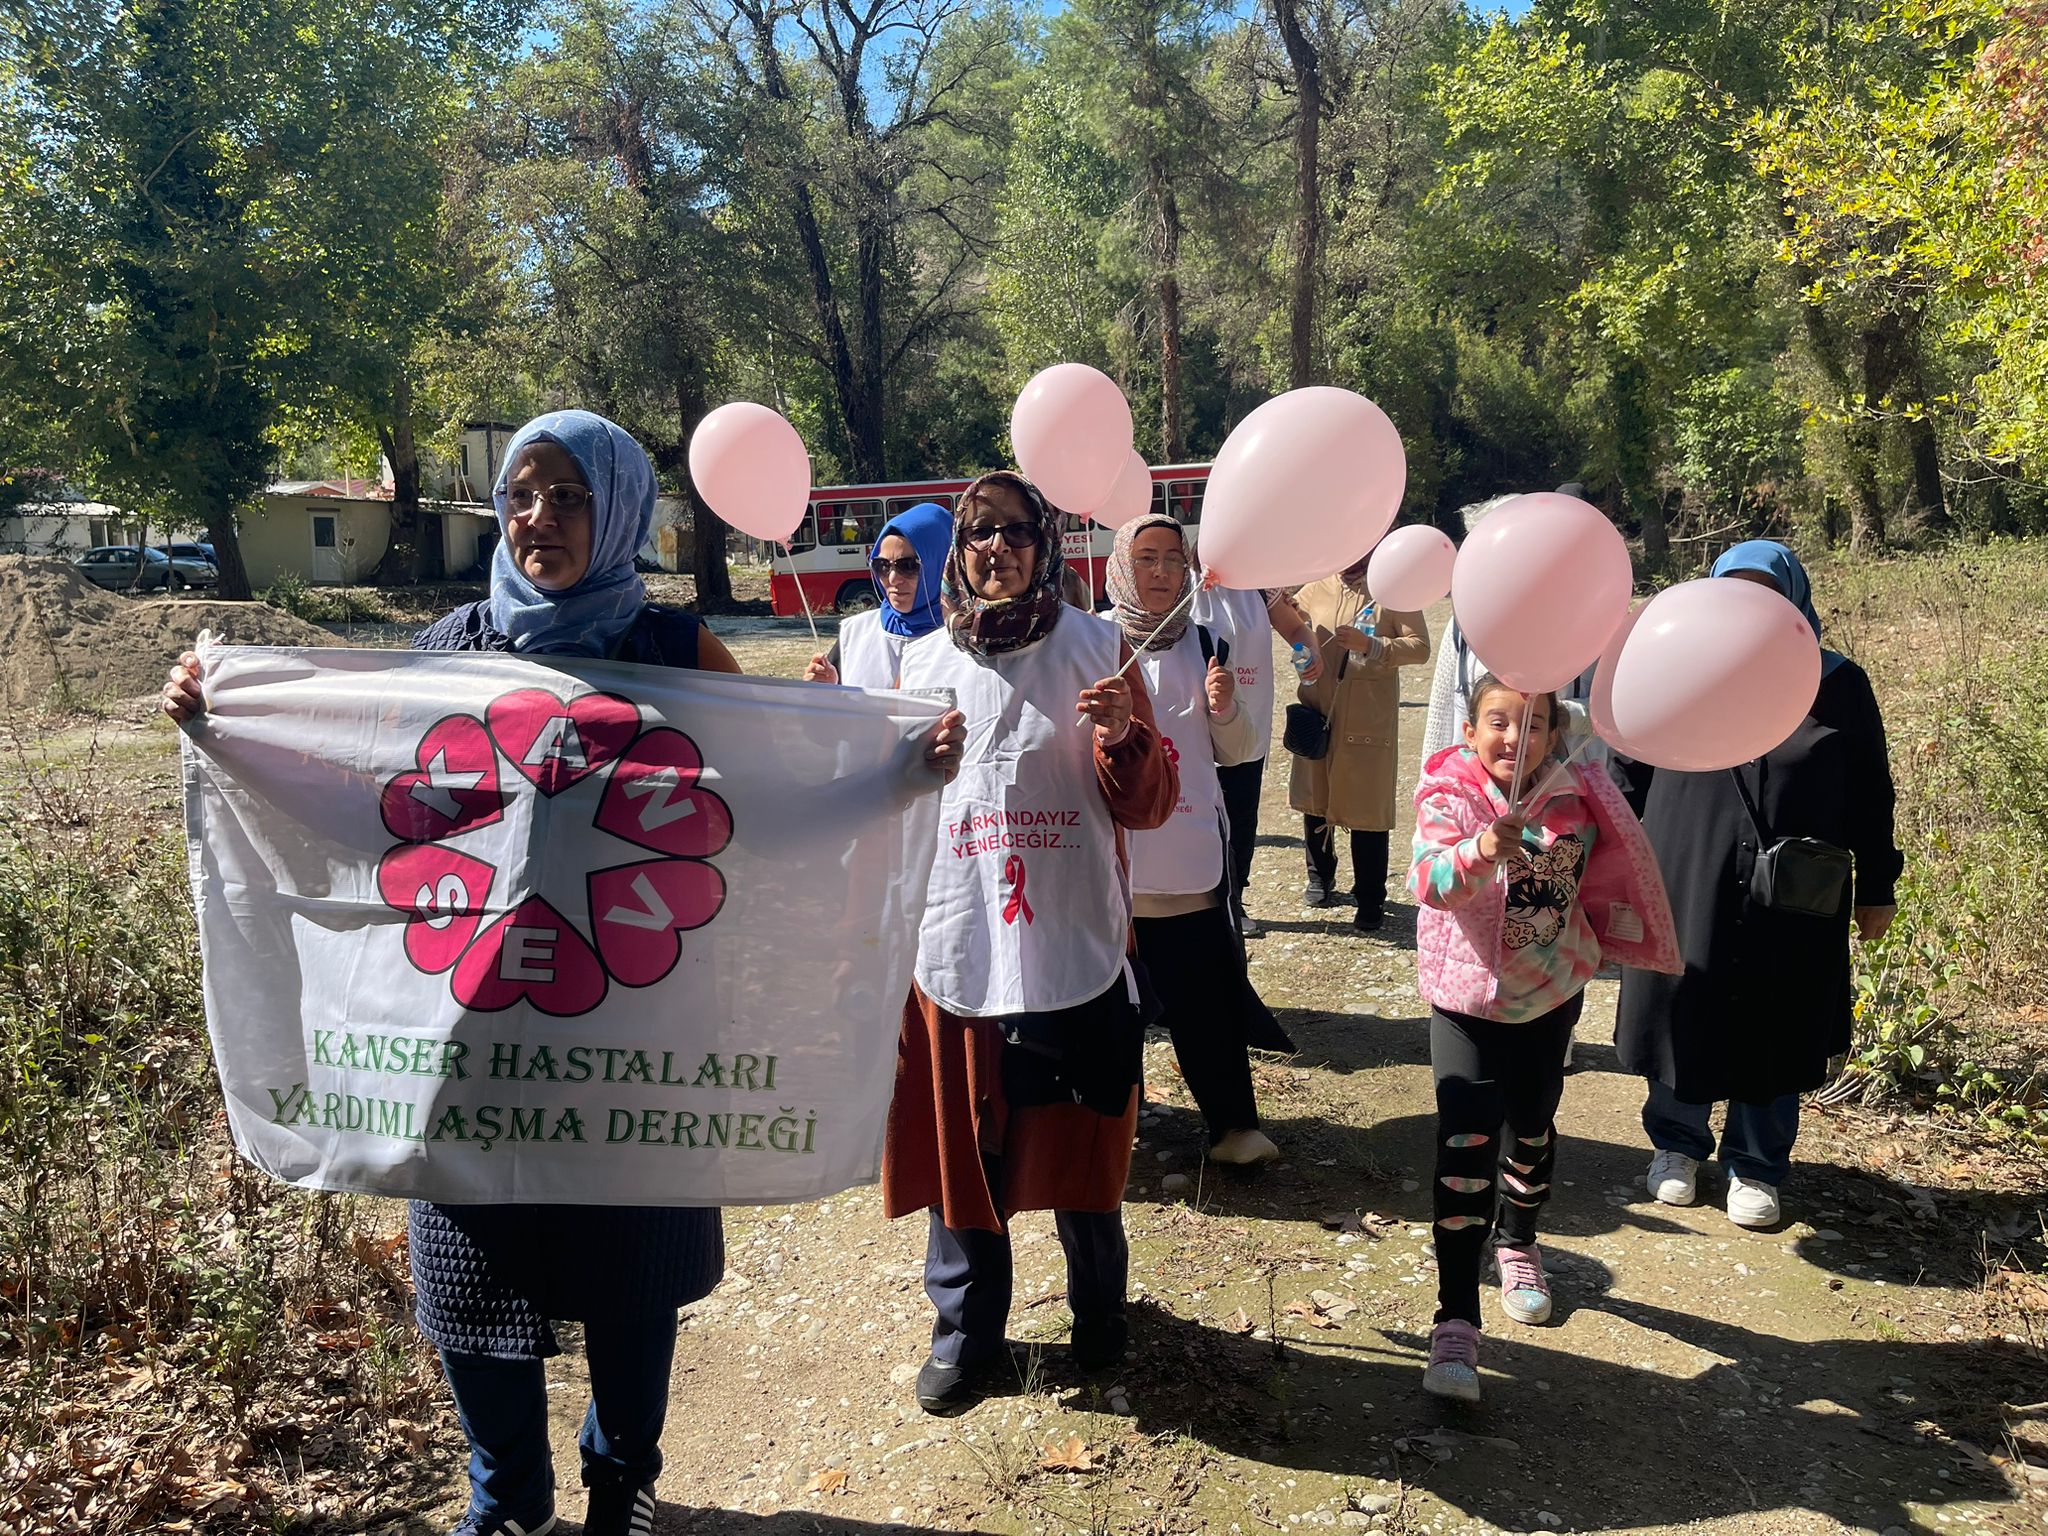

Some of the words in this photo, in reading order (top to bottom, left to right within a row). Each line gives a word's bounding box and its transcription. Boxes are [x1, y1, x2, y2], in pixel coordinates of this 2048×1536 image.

[1063, 533, 1093, 544] YESİ
[949, 811, 1081, 838] FARKINDAYIZ
[952, 829, 1081, 860] YENECEĞİZ...
[313, 1029, 472, 1081] KANSER
[488, 1043, 779, 1092] HASTALARI
[267, 1082, 588, 1151] YARDIMLAŞMA
[604, 1105, 818, 1154] DERNEĞİ
